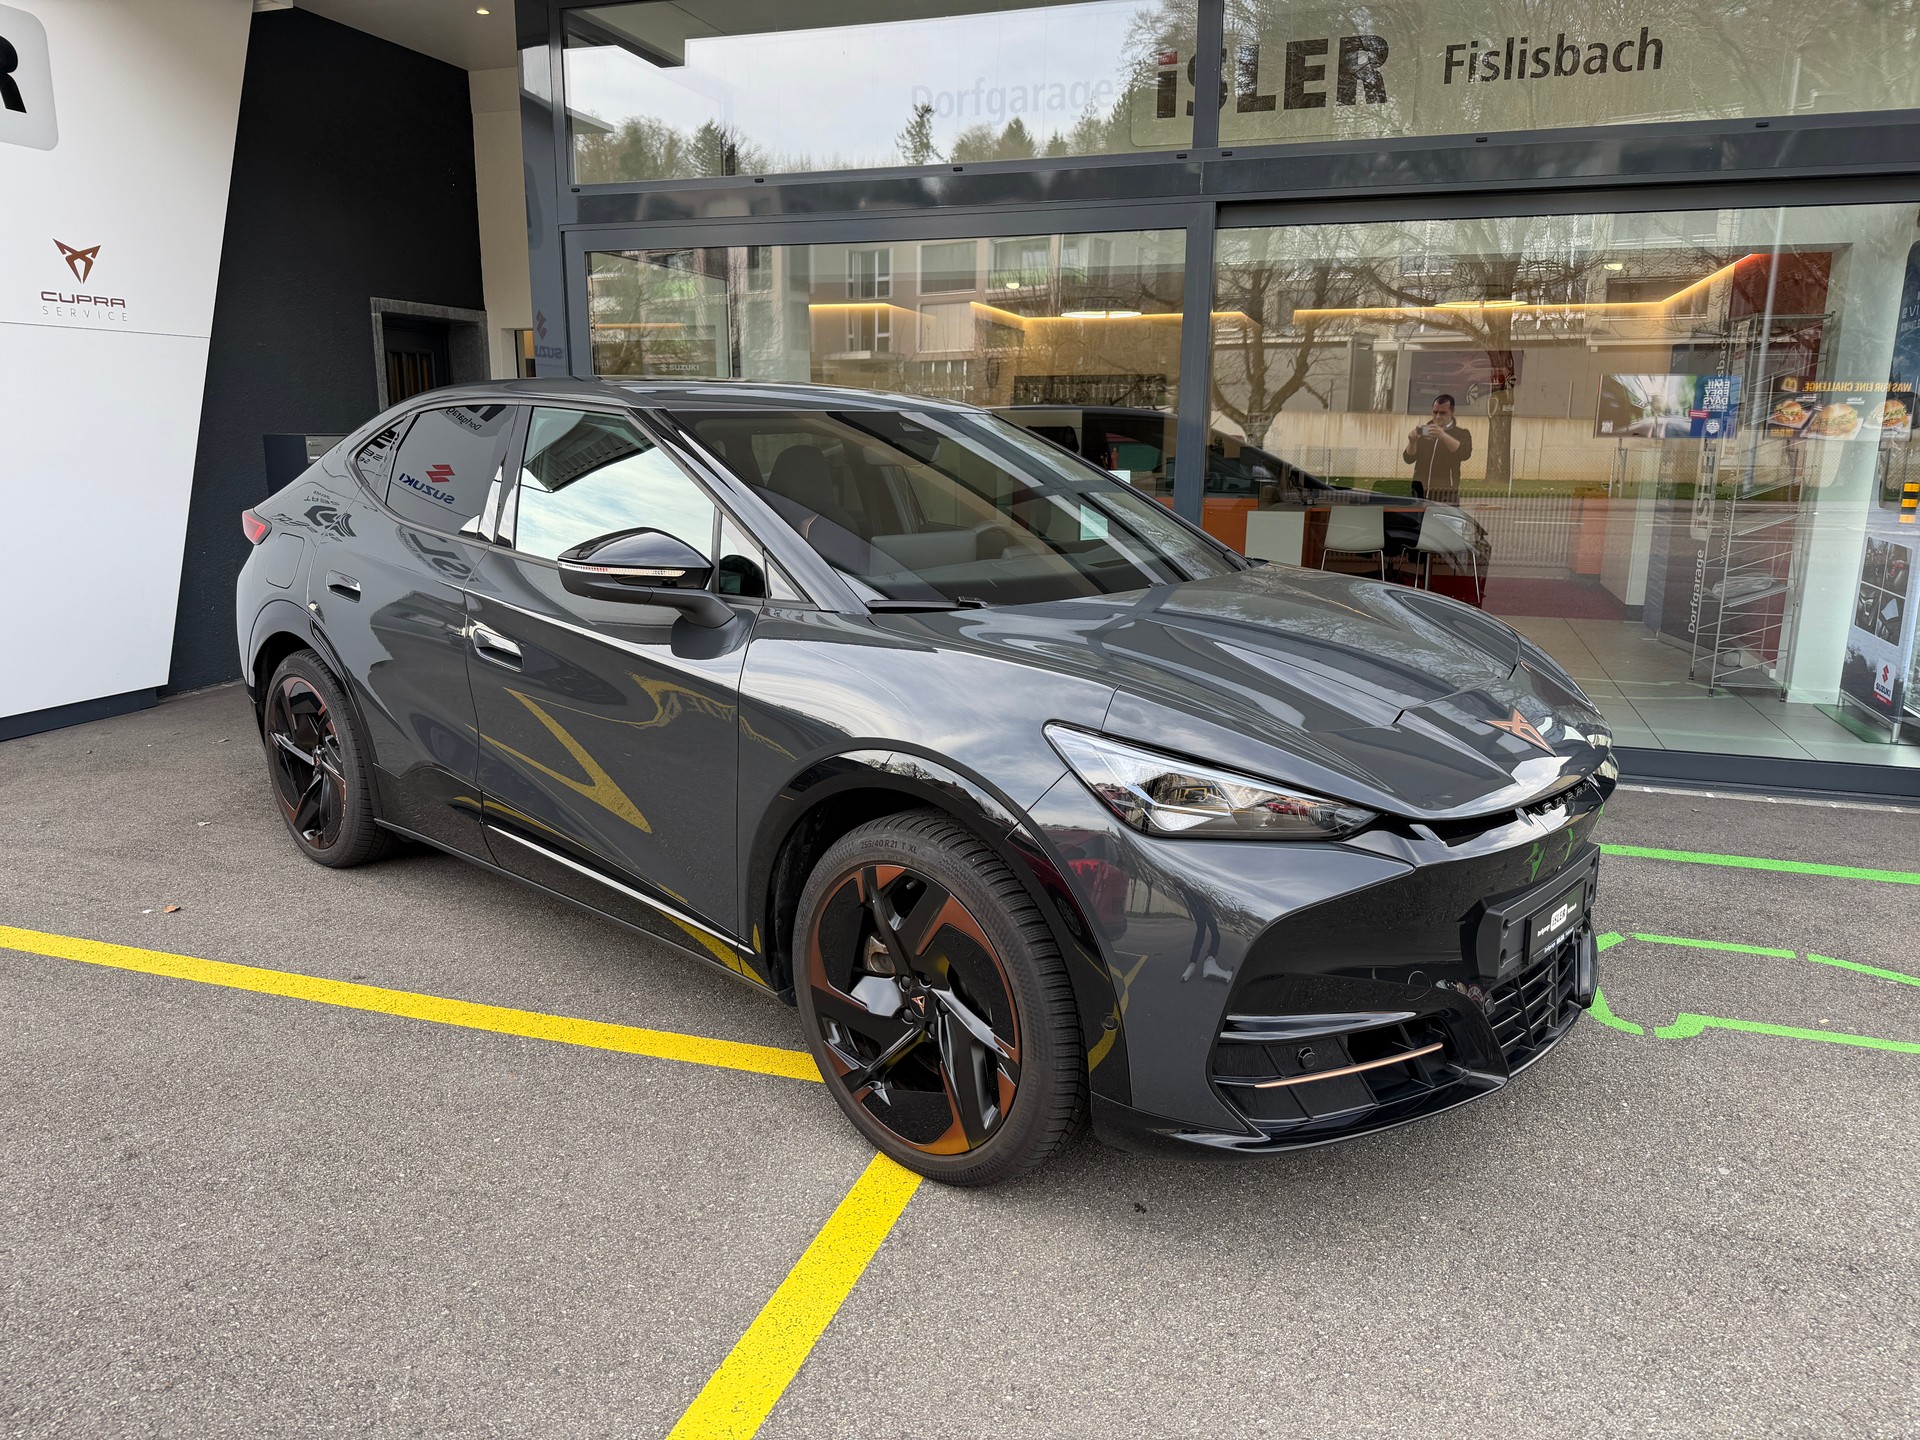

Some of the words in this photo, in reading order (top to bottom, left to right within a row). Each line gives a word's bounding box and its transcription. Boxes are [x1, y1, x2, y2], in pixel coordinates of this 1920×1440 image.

[911, 77, 1114, 126] Dorfgarage
[1444, 27, 1664, 84] Fislisbach
[40, 291, 127, 309] CUPRA
[43, 305, 128, 322] SERVICE
[1687, 549, 1705, 634] Dorfgarage
[1875, 682, 1892, 698] SUZUKI
[908, 844, 917, 854] XL
